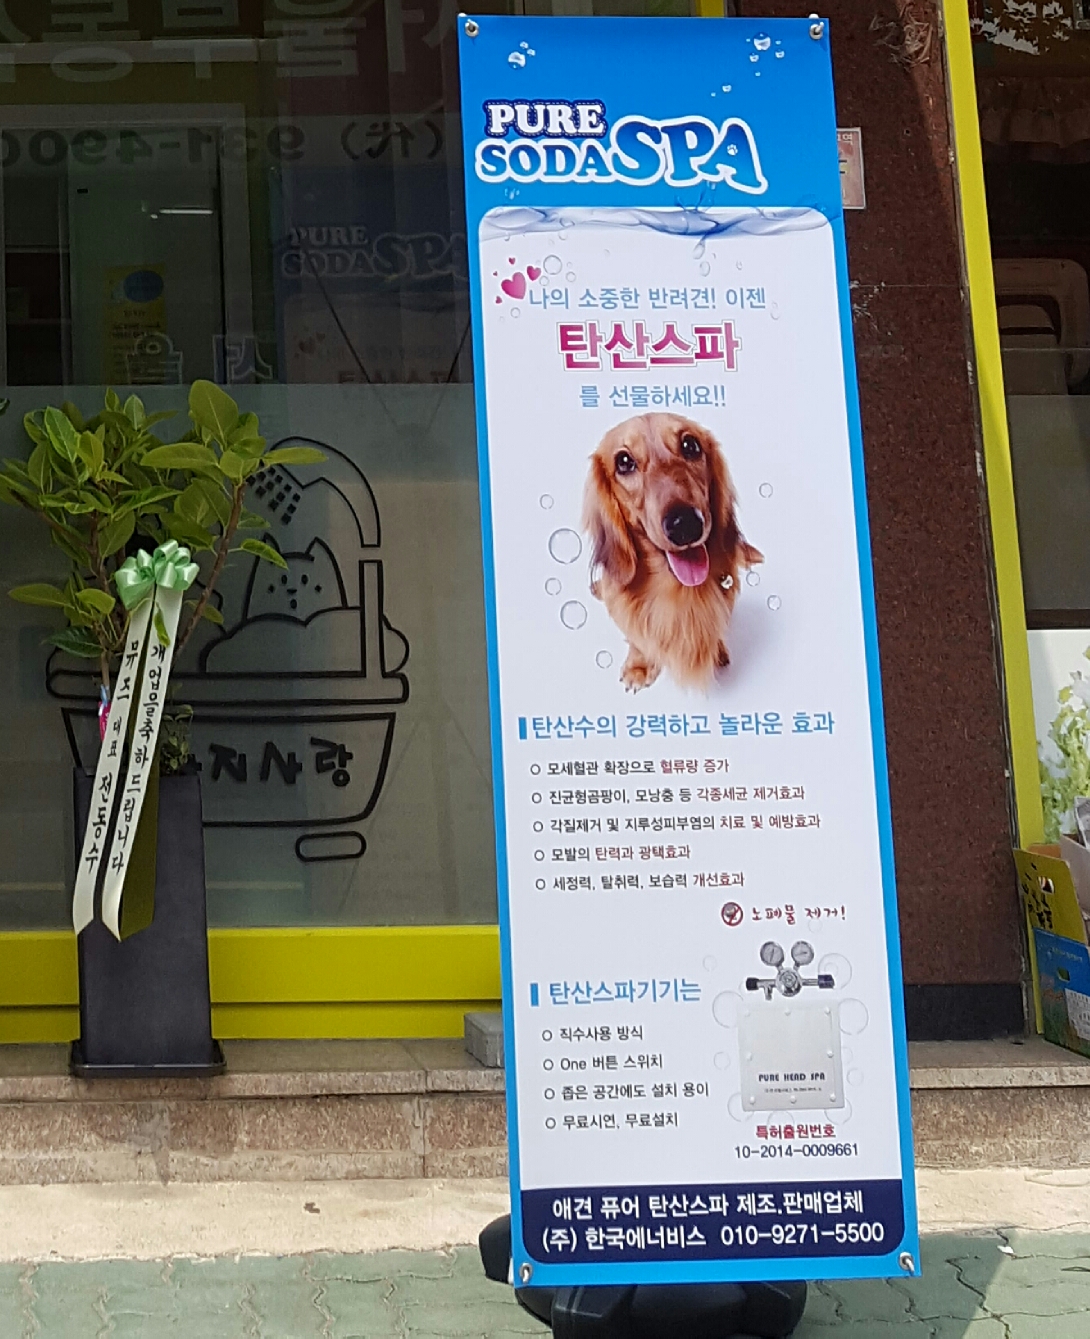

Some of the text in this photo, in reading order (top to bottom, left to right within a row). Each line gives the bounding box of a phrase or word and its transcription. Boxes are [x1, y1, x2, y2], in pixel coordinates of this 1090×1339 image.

[484, 99, 607, 138] PURE
[475, 115, 768, 194] SODA SPA
[530, 288, 765, 309] 나의 소중한 반려견! 이젠
[557, 320, 741, 371] 탄산스파
[578, 384, 725, 410] 를 선물하세요!!
[533, 712, 834, 739] 탄산수의 강력하고 놀라운 효과
[548, 759, 729, 775] 모세혈관 확장으로 혈류량 증가
[679, 789, 691, 802] 등
[697, 787, 747, 801] 각종세균
[754, 786, 804, 800] 제거효과
[551, 814, 820, 833] 각질제거 및 지루성피부염의 치료 및 예방효과
[552, 845, 690, 861] 모발의 탄력과 광택효과
[554, 872, 743, 890] 세정력, 탈취력, 보습력 개선효과
[753, 905, 845, 925] 노폐물 제거!
[550, 979, 701, 1004] 탄산스파기기는
[561, 1026, 642, 1041] 직수사용 방식
[561, 1054, 662, 1070] One 버튼 스위치
[562, 1083, 708, 1100] 좁은 공간에도 설치 용이
[563, 1113, 677, 1130] 무료시연, 무료설치
[756, 1124, 835, 1140] 특허출원번호
[735, 1143, 857, 1158] 10-2014-0009661
[553, 1190, 863, 1219] 애견 퓨어 탄산스파 제조.판매업체
[542, 1222, 884, 1252] (주) 한국에너비스 010-9271-5500
